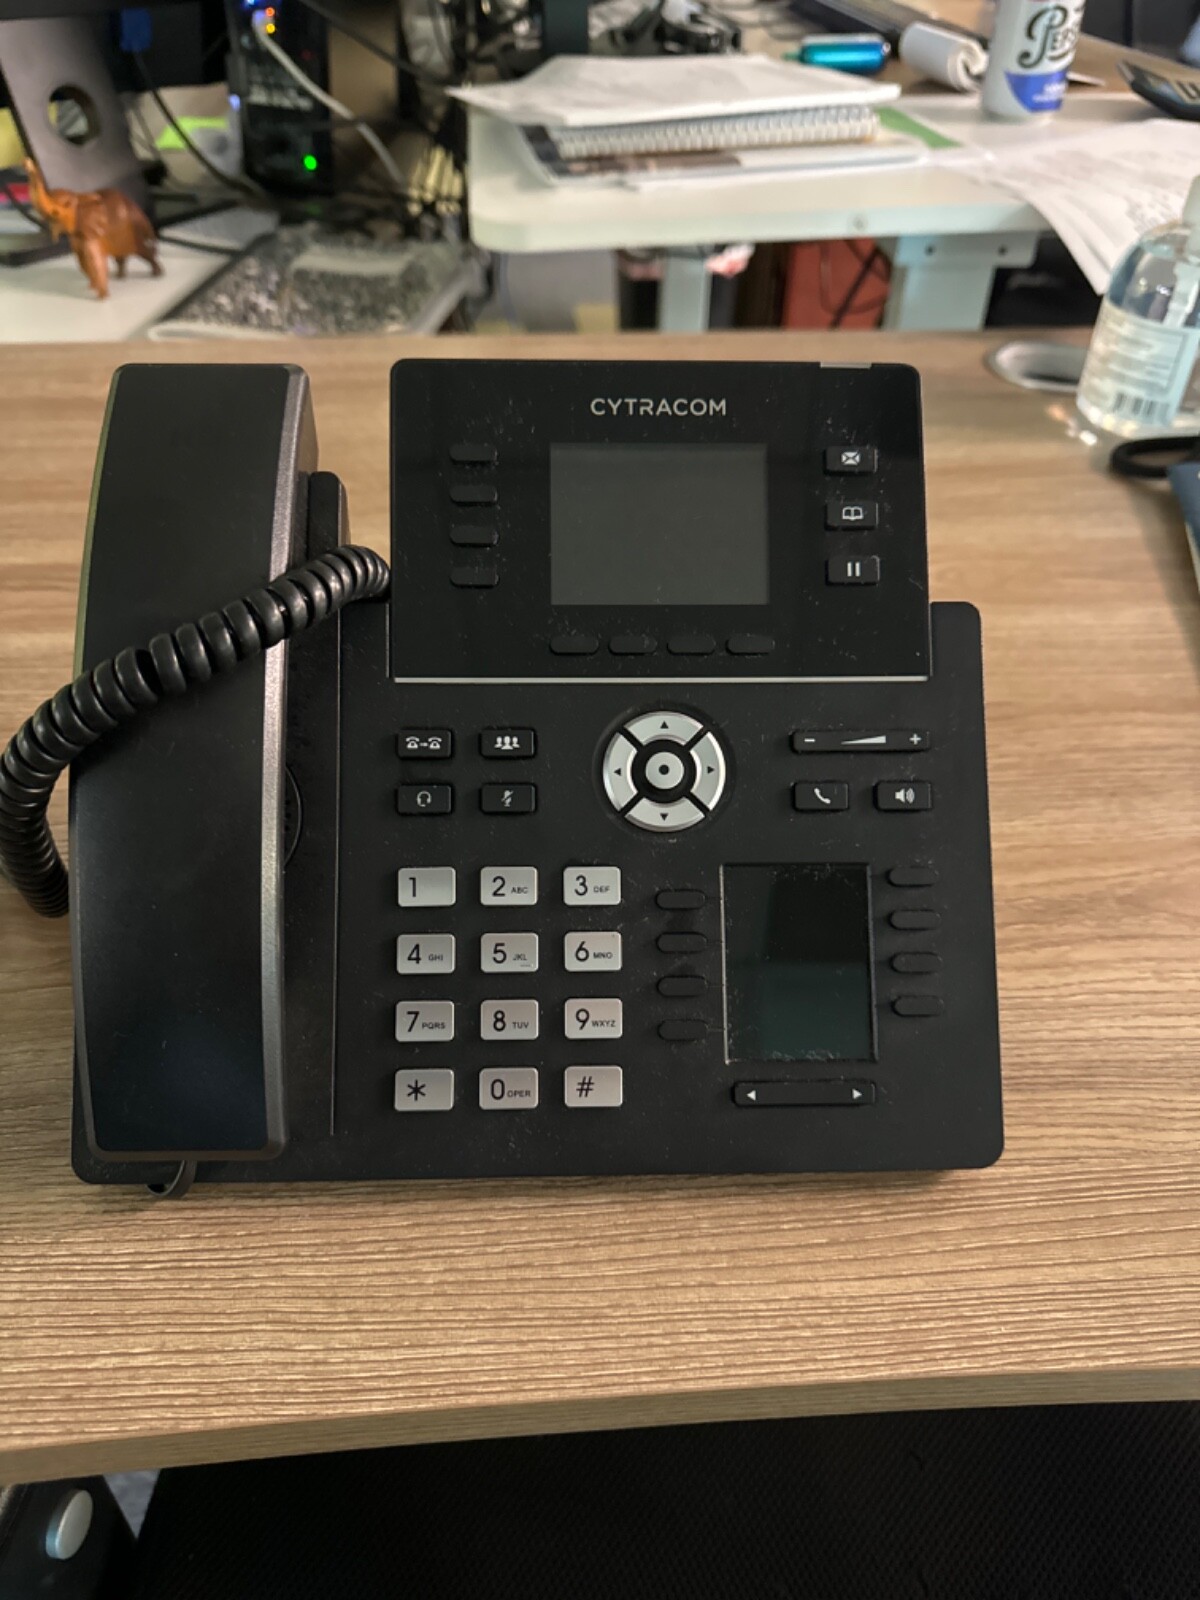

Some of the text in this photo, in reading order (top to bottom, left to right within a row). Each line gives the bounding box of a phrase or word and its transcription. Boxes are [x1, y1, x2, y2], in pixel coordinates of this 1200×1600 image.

[590, 397, 727, 416] CYTRACOM
[408, 876, 417, 898] 1
[492, 875, 528, 897] 2 ABC
[574, 874, 610, 896] 3 DEF
[407, 943, 444, 964] 4 GHI
[492, 942, 527, 964] 5 JKL
[574, 940, 590, 962] 6
[406, 1010, 446, 1032] 7 PQRS
[493, 1009, 529, 1032] 8 TUV
[575, 1008, 616, 1030] 9 WXYZ
[490, 1078, 531, 1100] 0 OPER
[576, 1076, 595, 1098] #
